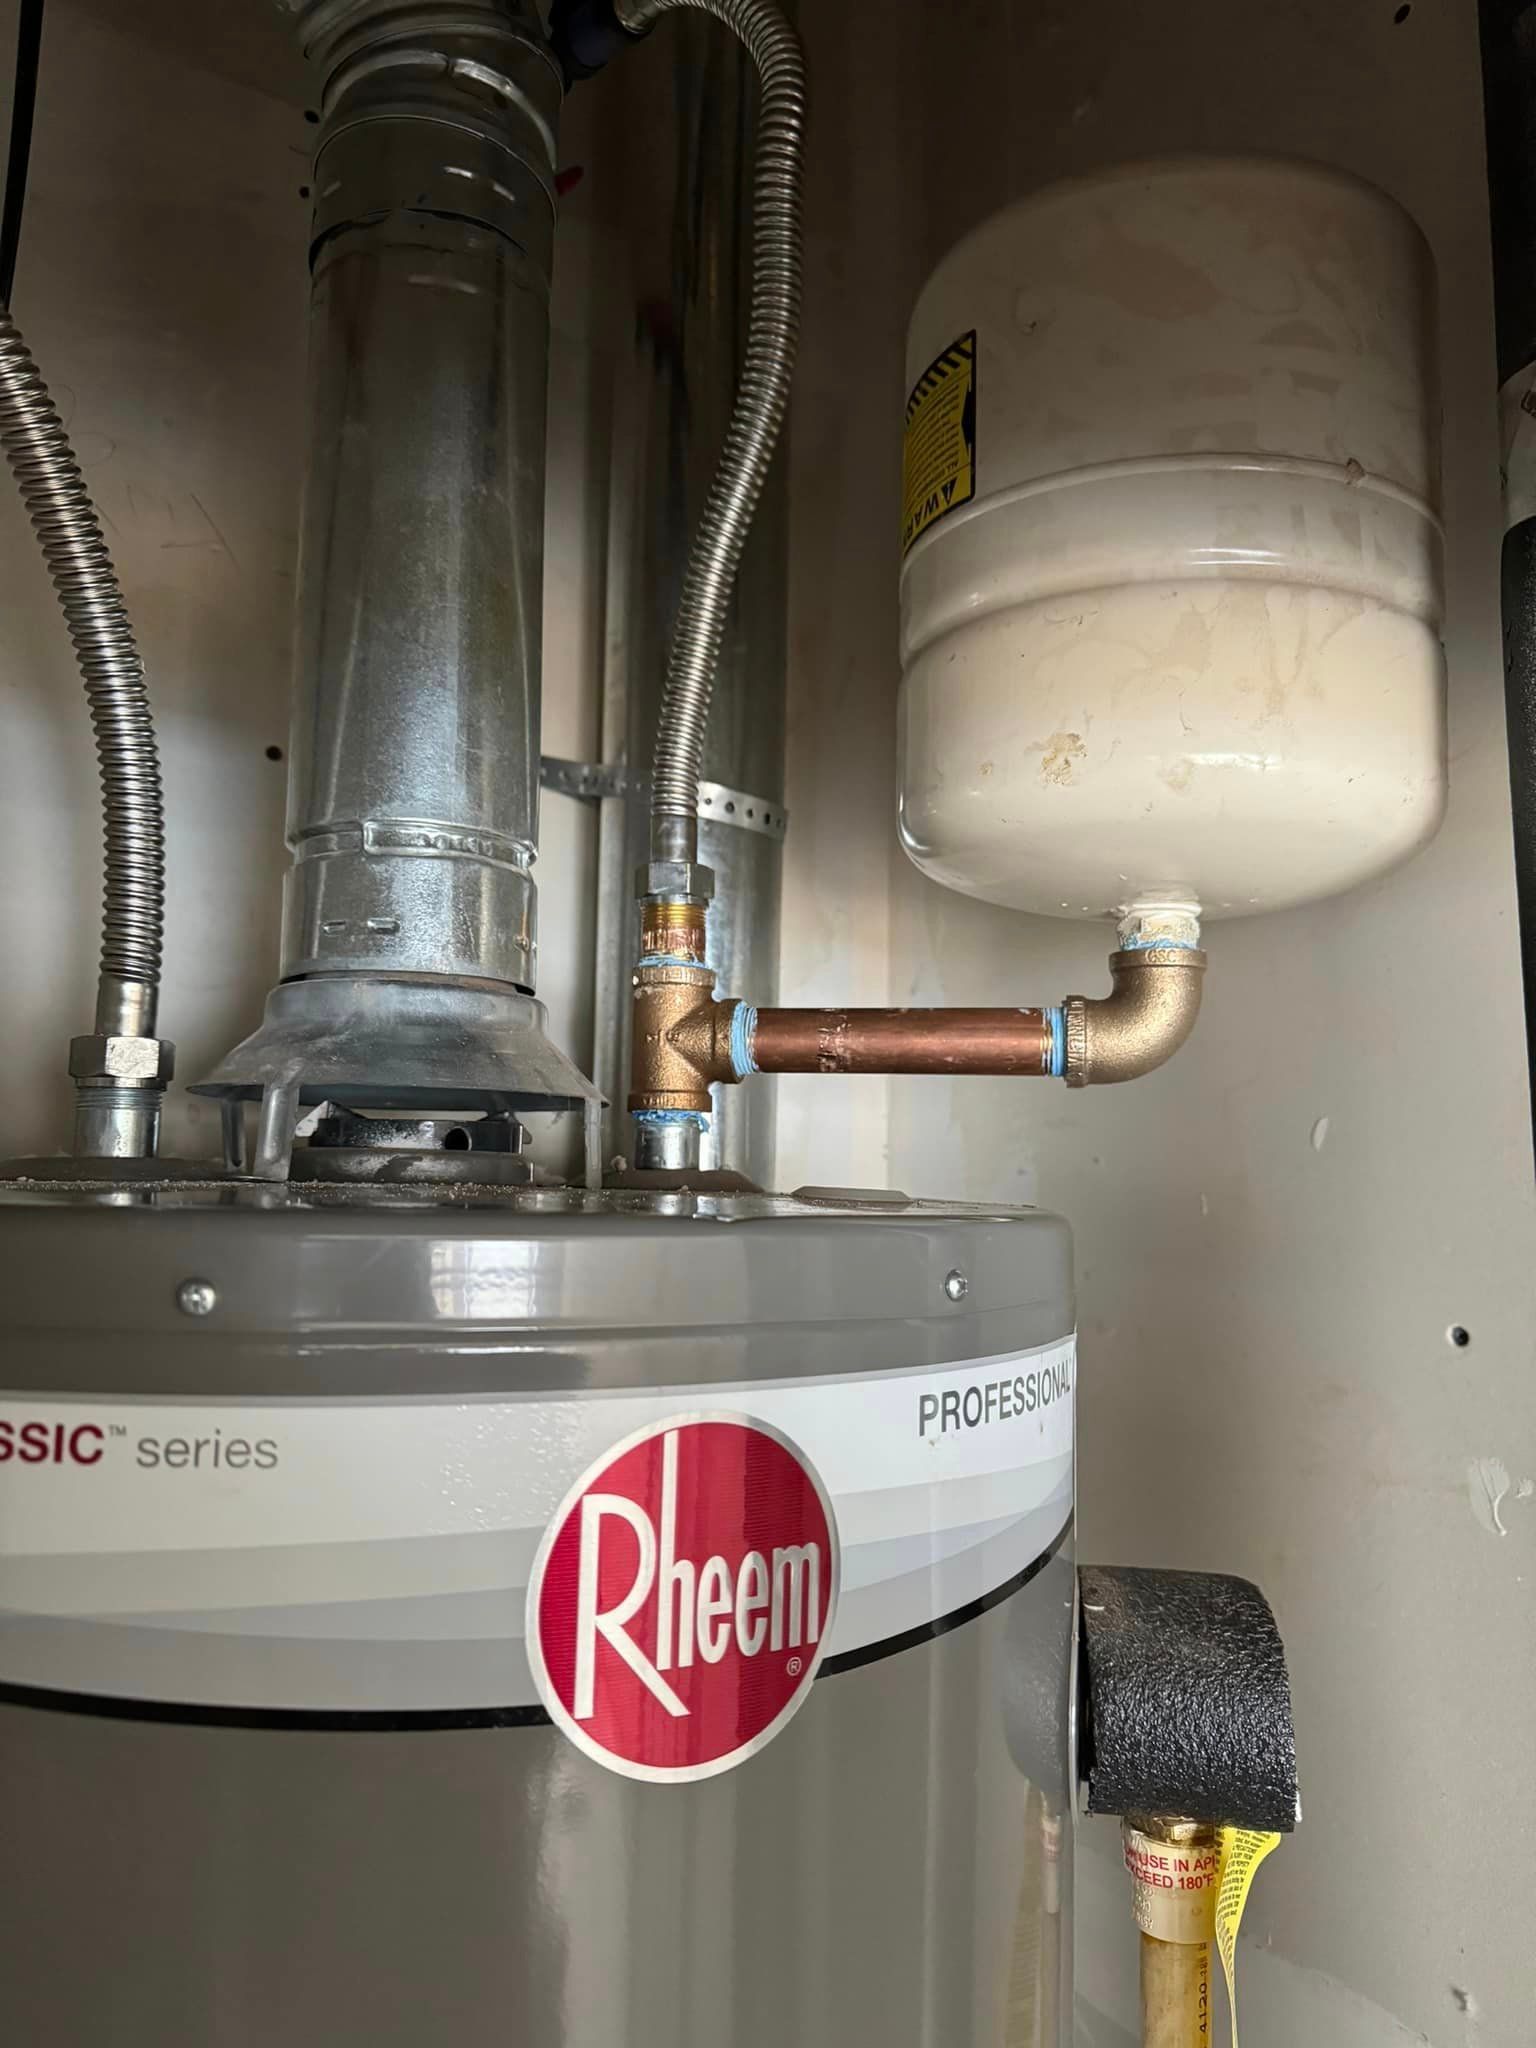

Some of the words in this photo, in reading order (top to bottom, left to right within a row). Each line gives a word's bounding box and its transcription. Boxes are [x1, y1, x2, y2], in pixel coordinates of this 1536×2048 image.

[919, 1359, 1071, 1437] PROFESSIONAL
[136, 1429, 279, 1469] series
[573, 1429, 820, 1720] Rheem
[1139, 1853, 1169, 1871] USE
[1174, 1858, 1189, 1872] IN
